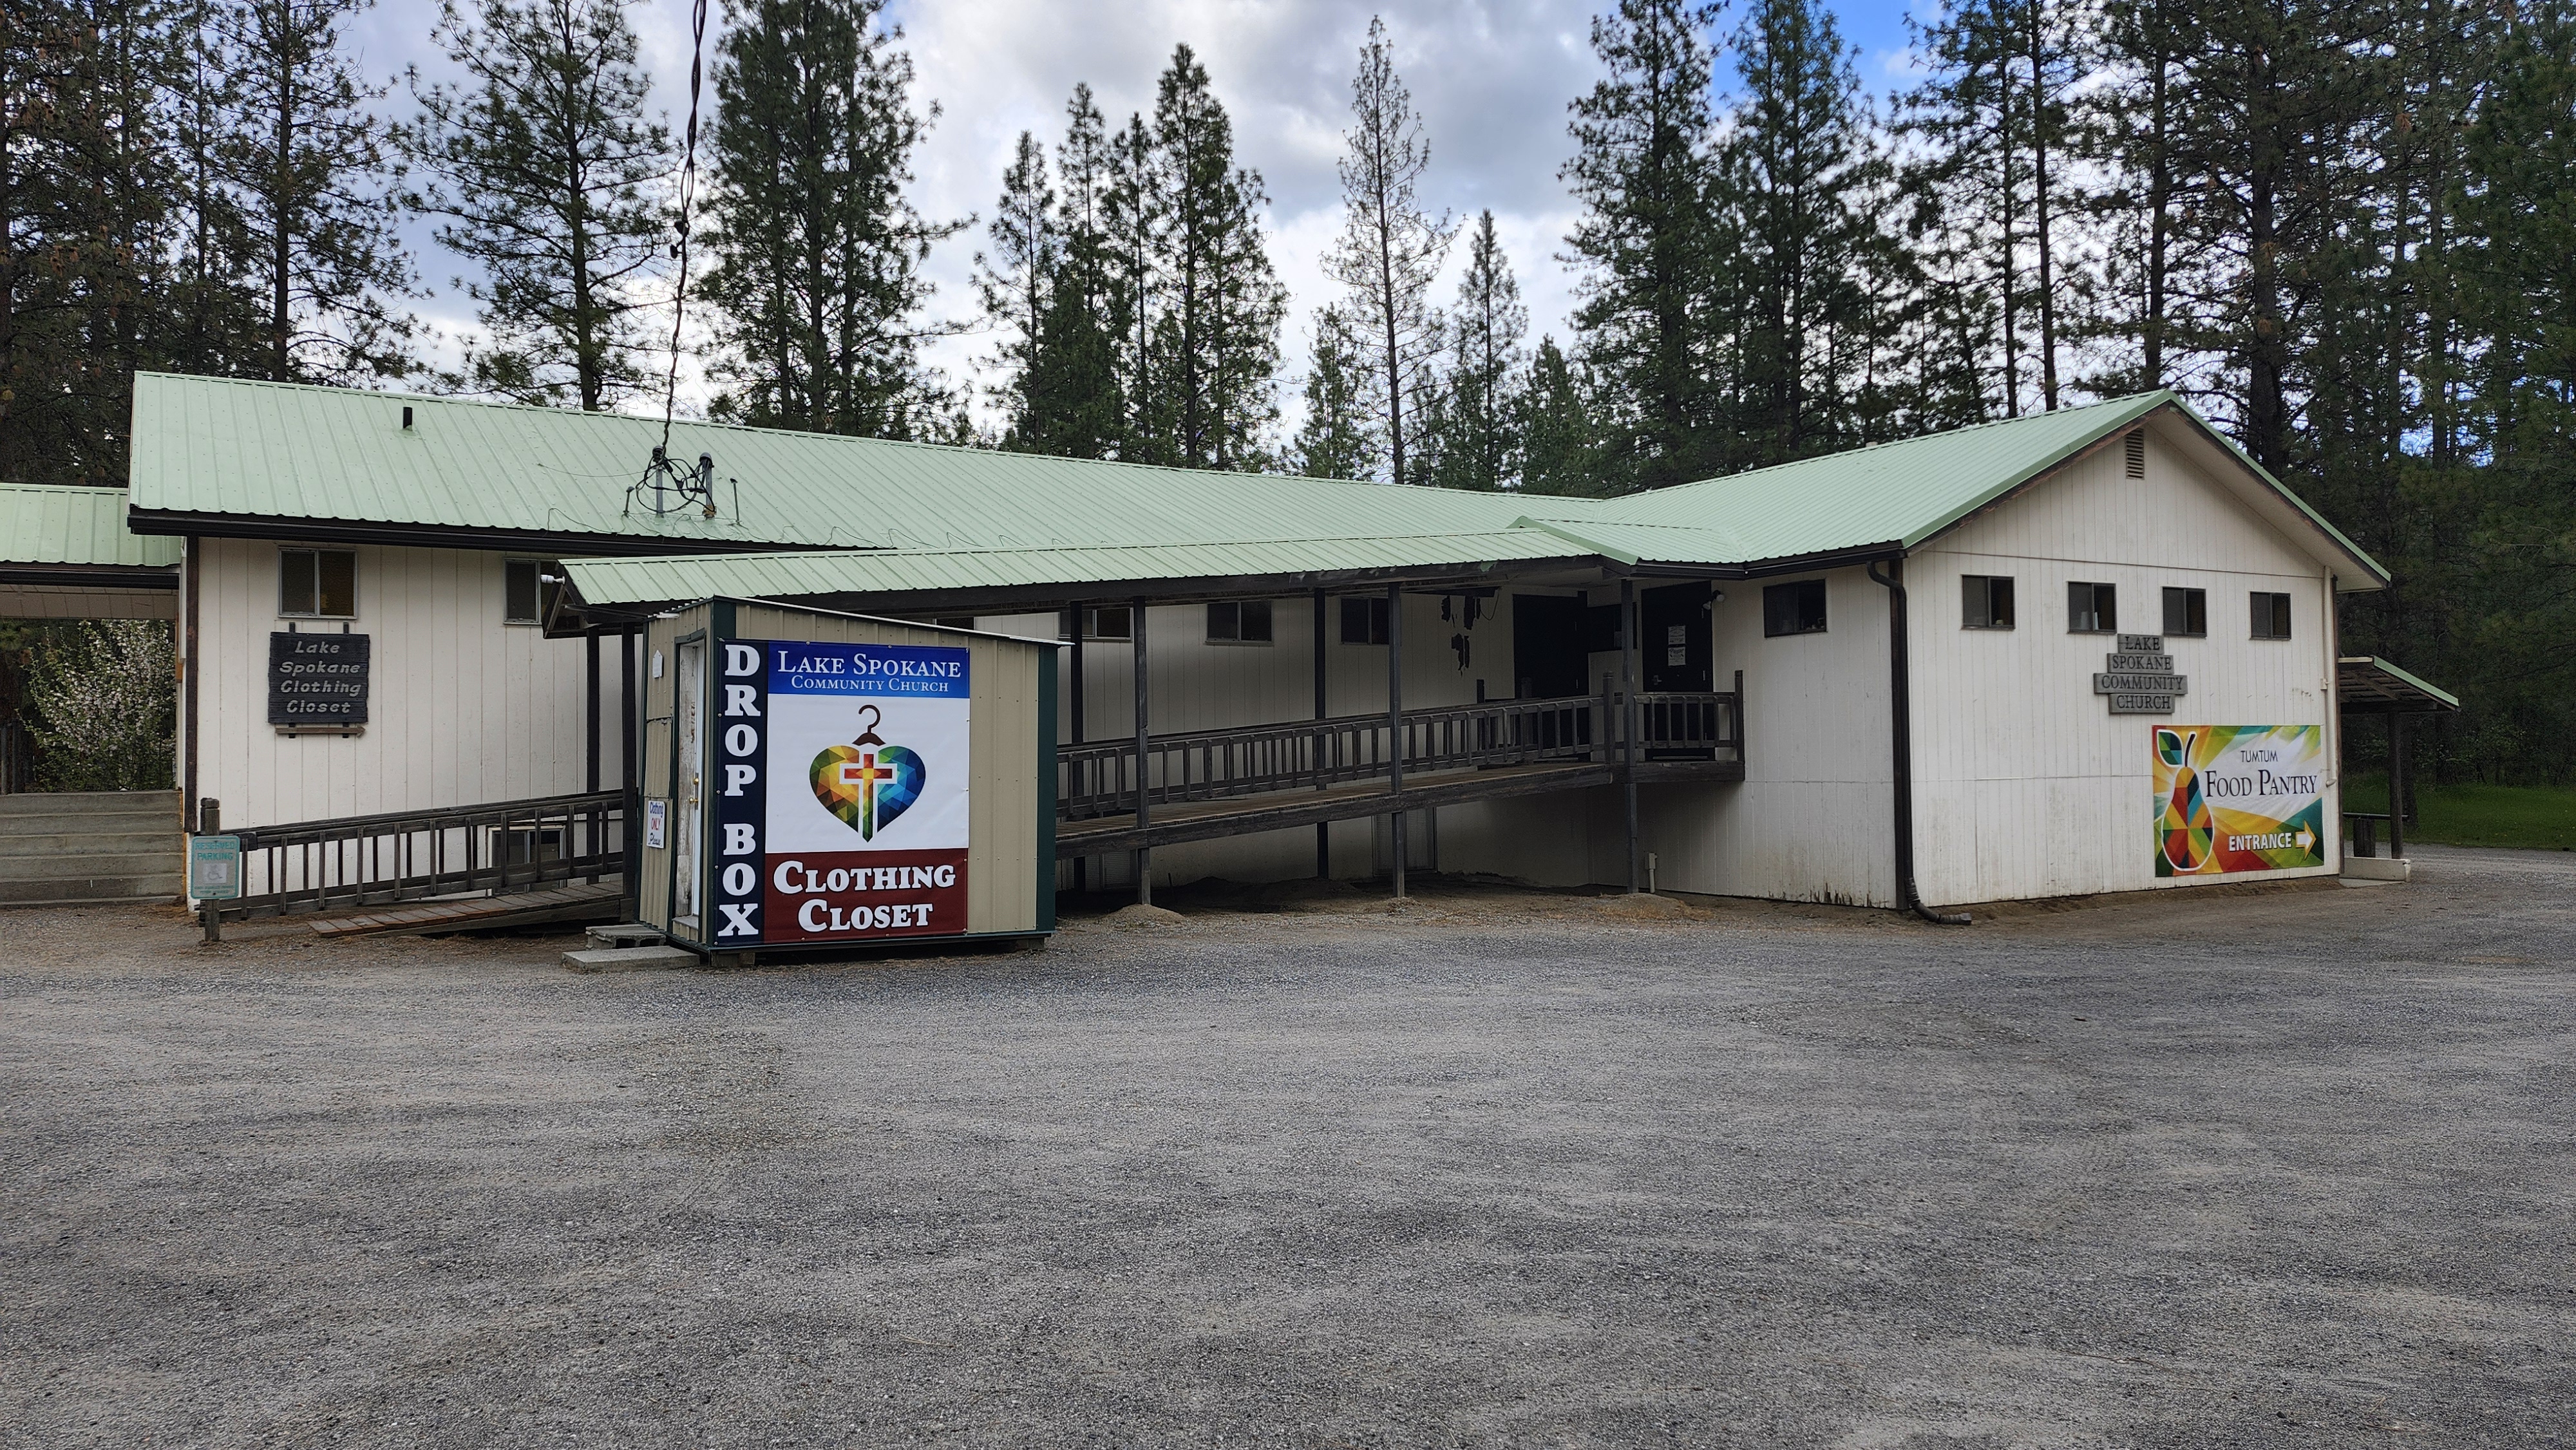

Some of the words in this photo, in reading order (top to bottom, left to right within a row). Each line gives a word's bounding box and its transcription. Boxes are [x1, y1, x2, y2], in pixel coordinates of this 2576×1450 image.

[294, 641, 340, 654] Lake
[2125, 636, 2161, 650] LAKE
[279, 660, 361, 677] Spokane
[777, 650, 846, 674] LAKE
[853, 654, 961, 678] SPOKANE
[2112, 655, 2172, 672] SPOKANE
[280, 680, 361, 697] Clothing
[791, 674, 885, 692] COMMUNITY
[888, 677, 949, 693] CHURCH
[2101, 675, 2183, 692] COMMUNITY
[286, 699, 352, 713] Closet
[2117, 695, 2171, 710] CHURCH
[724, 645, 761, 797] DROP
[2240, 749, 2278, 763] TUMTUM
[2204, 770, 2253, 798] FOOD
[2258, 769, 2317, 796] PANTRY
[2228, 832, 2293, 852] ENTRANCE
[197, 852, 234, 861] PARKING
[717, 823, 759, 937] BOX
[773, 860, 956, 894] CLOTHING
[797, 898, 934, 932] CLOSET
